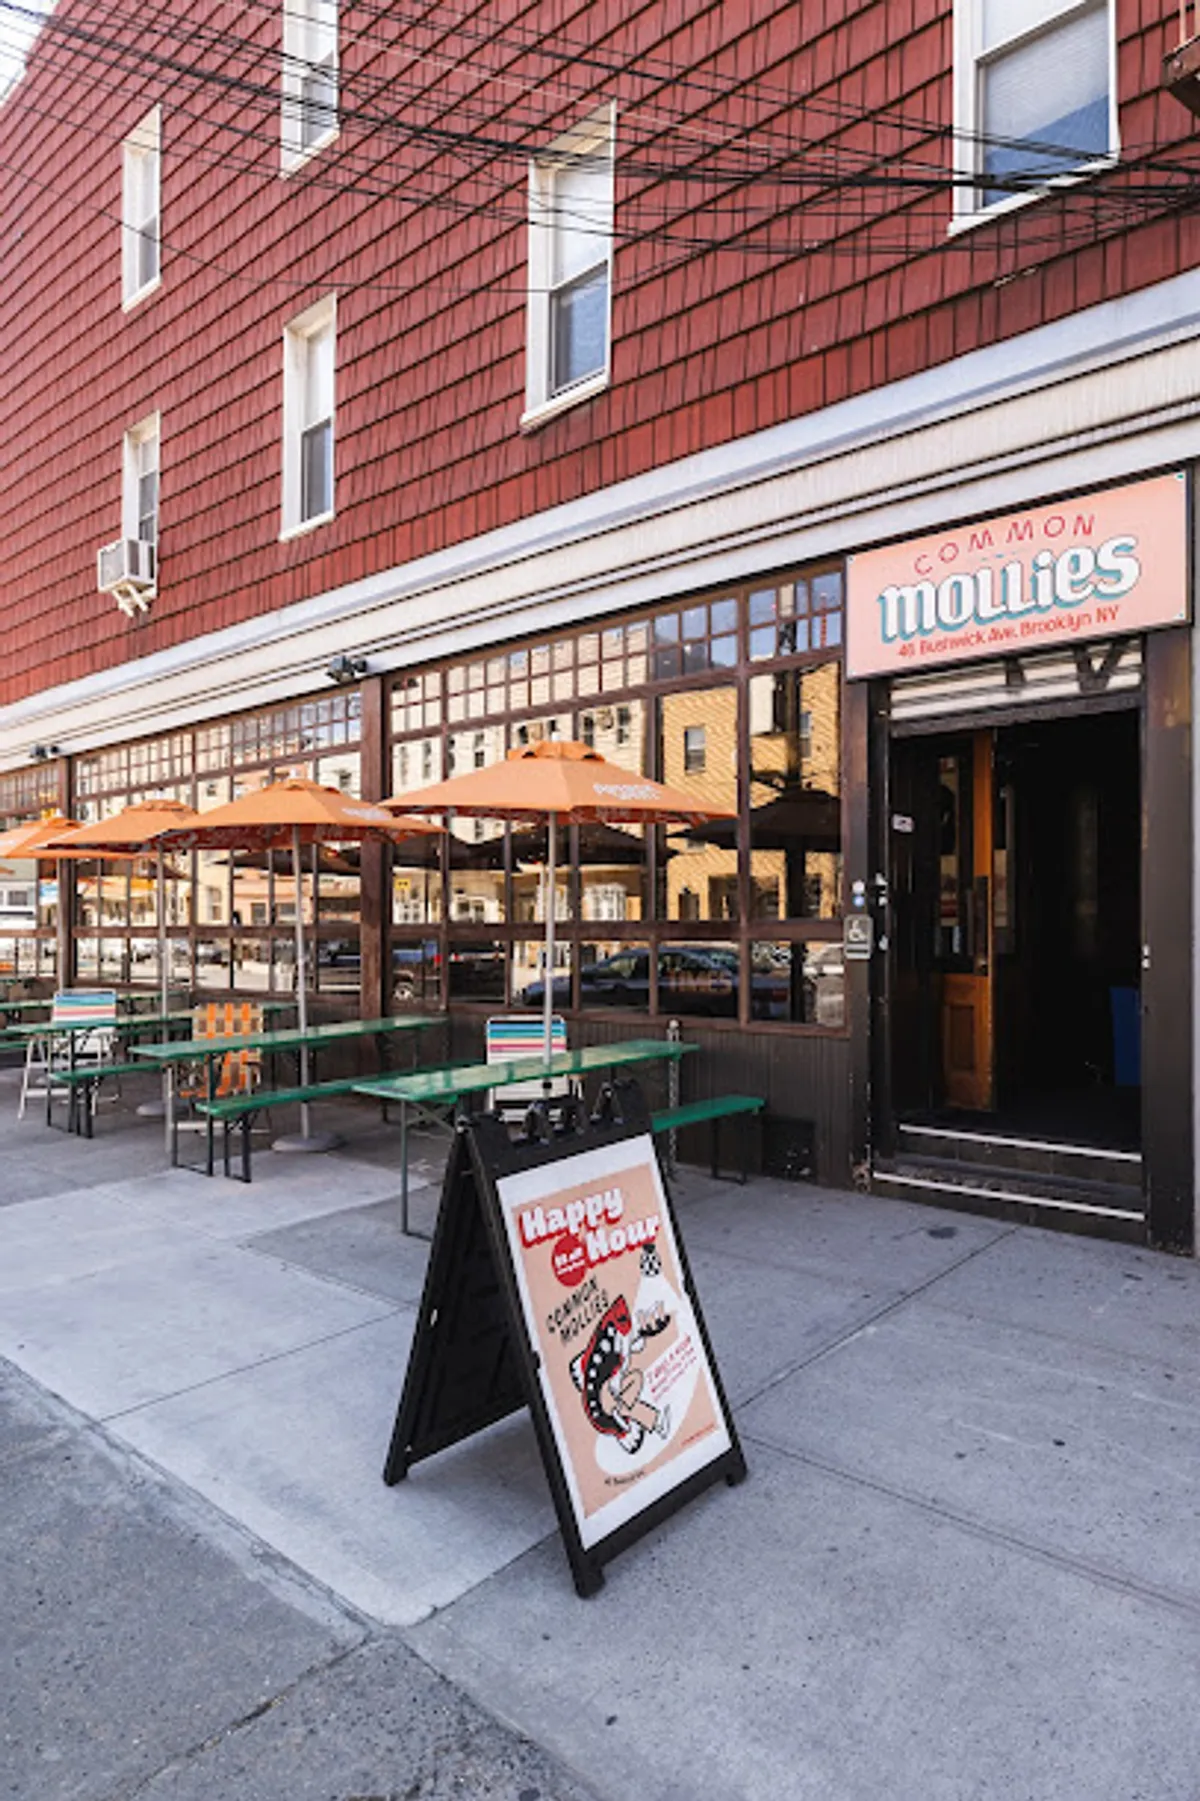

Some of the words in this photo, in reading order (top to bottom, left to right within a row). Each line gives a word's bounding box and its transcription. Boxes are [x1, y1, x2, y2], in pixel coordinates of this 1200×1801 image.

[914, 513, 1096, 576] COMMON
[1019, 613, 1093, 638] Brooklyn
[1096, 604, 1121, 623] NY
[518, 1187, 624, 1249] Happy
[583, 1213, 660, 1269] Hour
